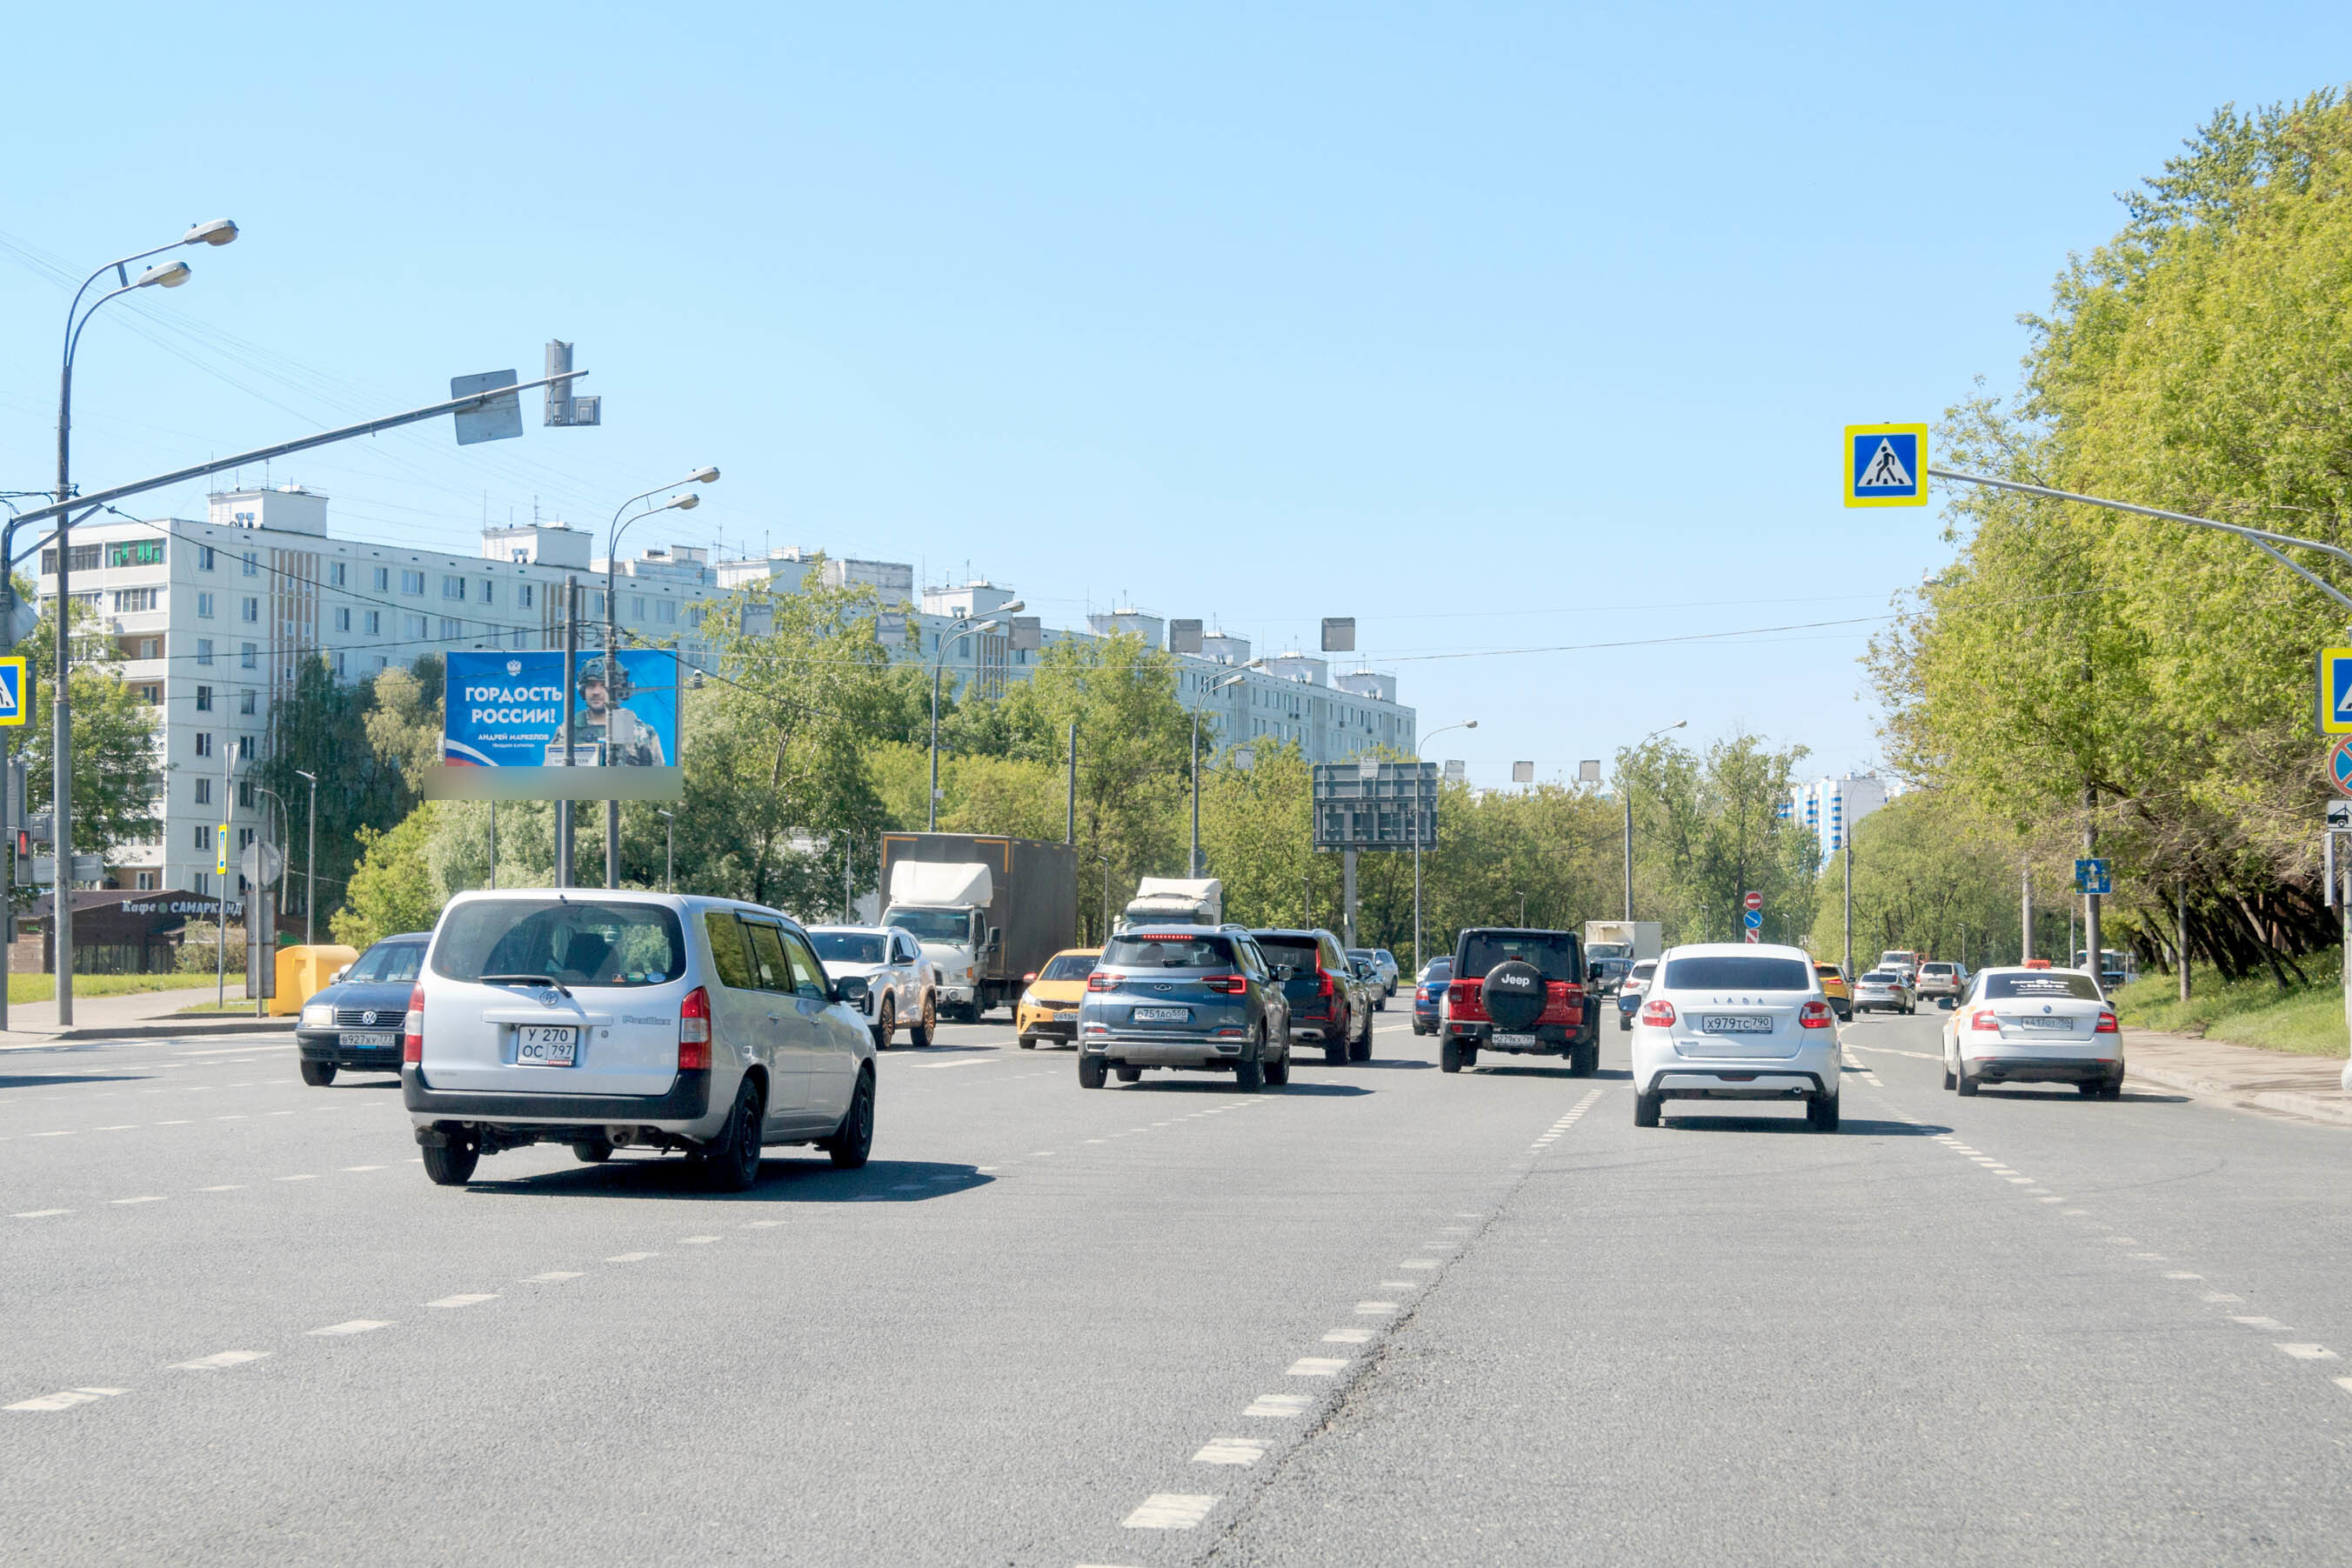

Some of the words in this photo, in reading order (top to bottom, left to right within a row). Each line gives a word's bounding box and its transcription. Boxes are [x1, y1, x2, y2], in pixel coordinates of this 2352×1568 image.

[465, 686, 564, 704] ГОРДОСТЬ
[471, 708, 556, 724] РОССИИ!
[478, 732, 508, 741] АНДРЕЙ
[122, 900, 156, 915] Кафе
[1501, 973, 1530, 987] Jeep
[528, 1028, 537, 1042] У
[543, 1029, 568, 1042] 270
[522, 1044, 544, 1058] ОС
[551, 1044, 572, 1056] 797
